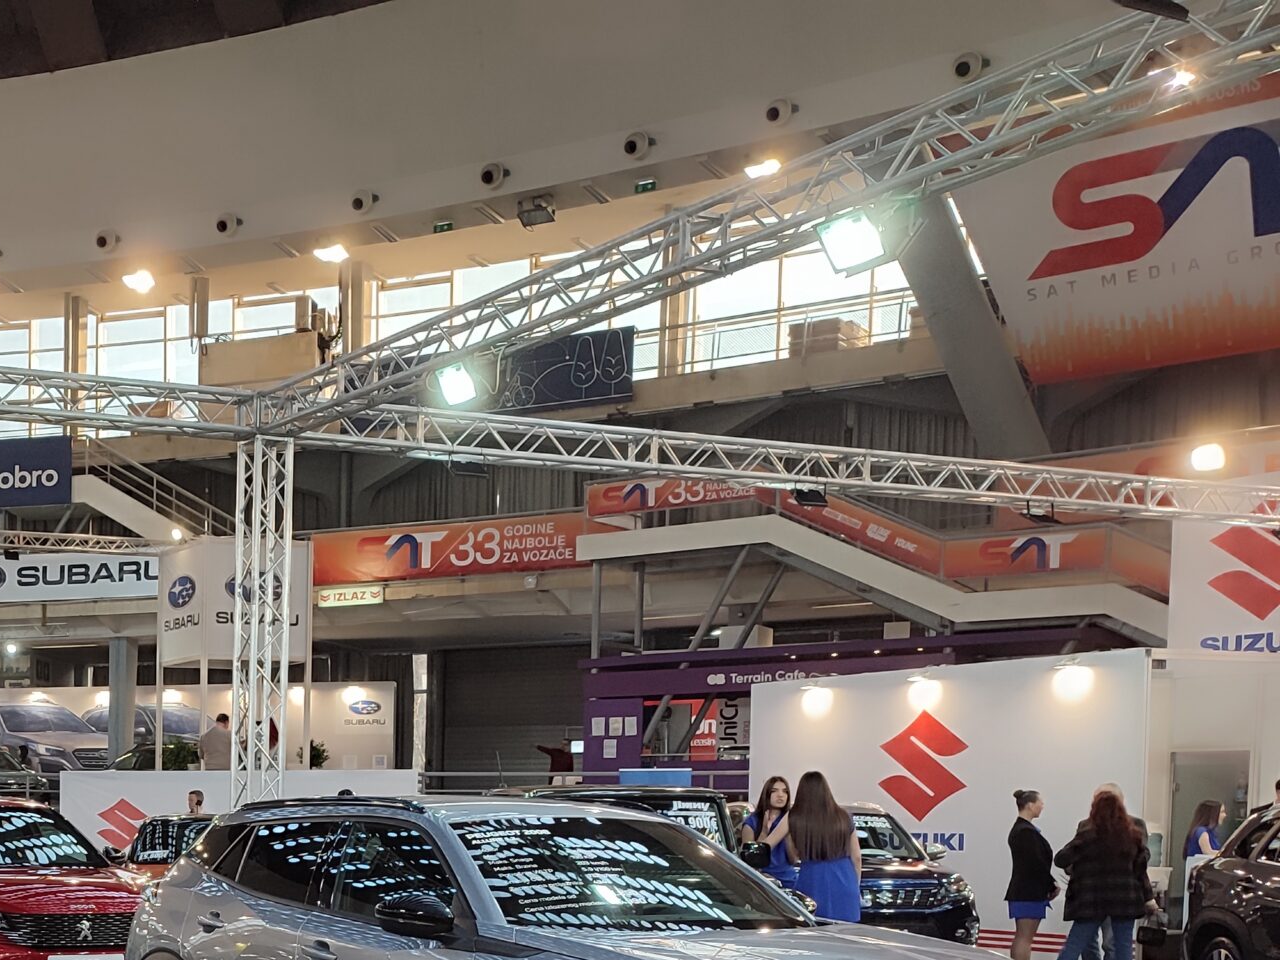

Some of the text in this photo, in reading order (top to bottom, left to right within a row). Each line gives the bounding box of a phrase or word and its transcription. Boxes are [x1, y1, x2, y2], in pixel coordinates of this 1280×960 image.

[1026, 281, 1078, 302] SAT
[1101, 258, 1201, 288] MEDIA
[705, 491, 718, 500] ZA
[503, 522, 555, 537] GODINE
[503, 536, 566, 550] NAJBOLJE
[502, 545, 574, 564] ZA VOZAČE
[17, 560, 158, 587] SUBARU
[333, 590, 367, 602] IZLAZ
[164, 612, 200, 632] SUBARU
[730, 669, 807, 684] Terrain Cafe
